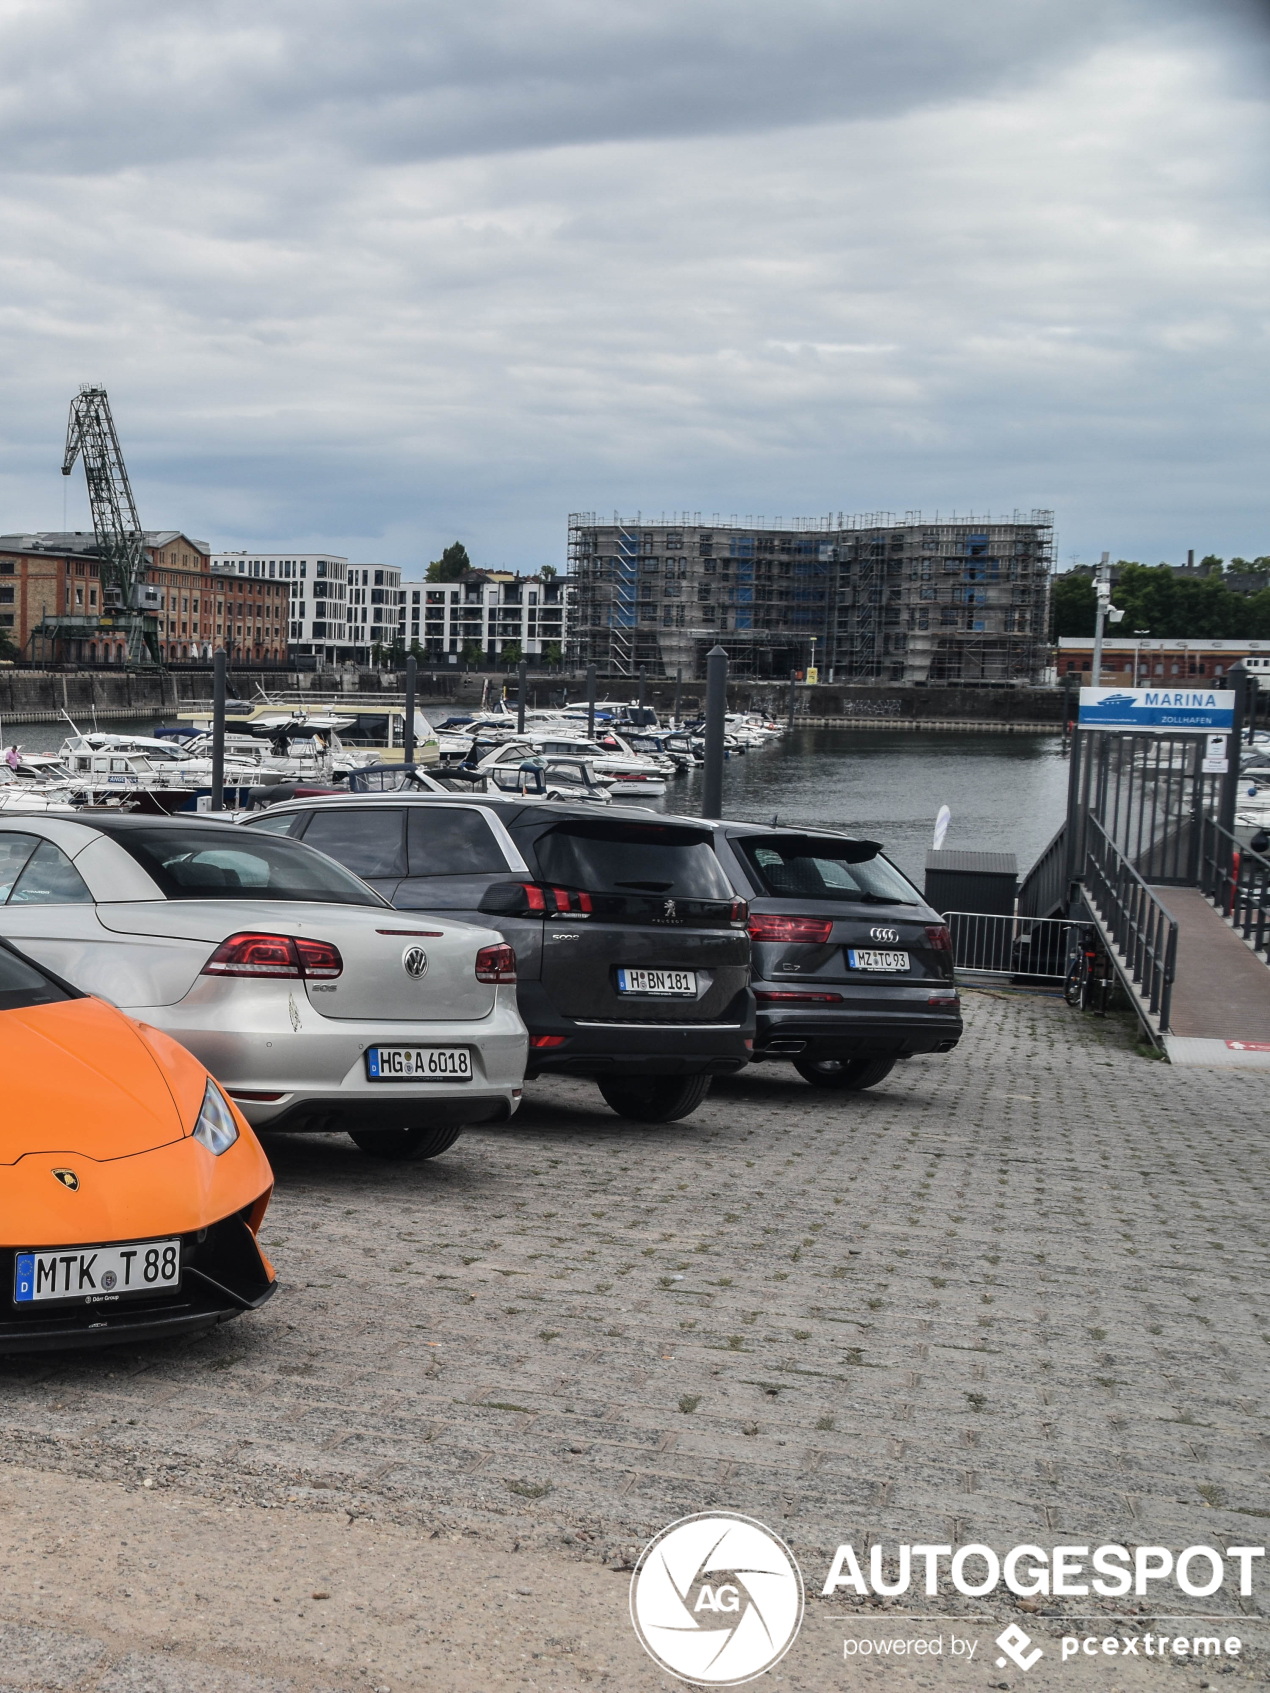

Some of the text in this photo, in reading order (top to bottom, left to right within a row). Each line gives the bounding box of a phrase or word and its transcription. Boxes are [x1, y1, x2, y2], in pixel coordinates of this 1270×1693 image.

[1145, 692, 1216, 707] MARINA
[1161, 715, 1213, 724] ZOLLHAFEN
[782, 963, 801, 972] Q7
[858, 951, 873, 966] MZ
[878, 952, 892, 967] TC
[893, 953, 906, 968] 93
[630, 971, 640, 989] H
[648, 972, 665, 990] BN
[667, 973, 691, 991] 181
[380, 1051, 403, 1073] HG
[415, 1052, 425, 1073] A
[428, 1052, 468, 1073] 6018
[21, 1247, 176, 1294] D MTK T 88
